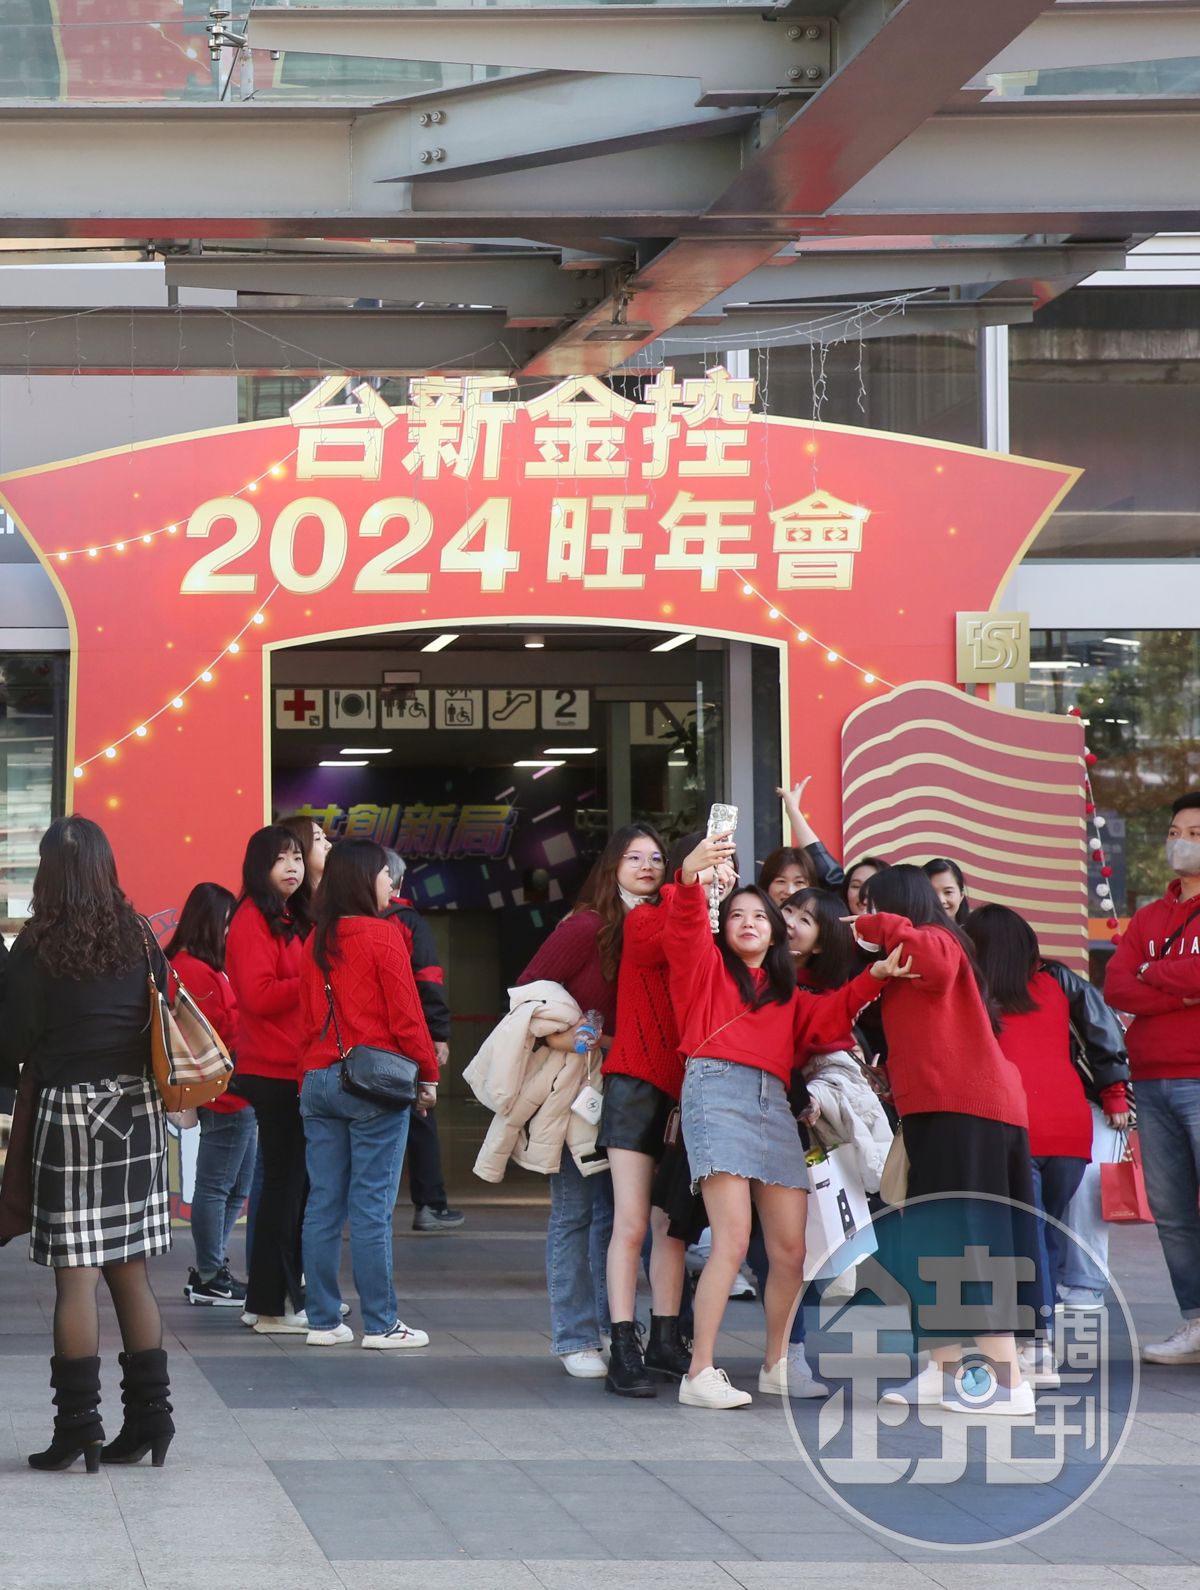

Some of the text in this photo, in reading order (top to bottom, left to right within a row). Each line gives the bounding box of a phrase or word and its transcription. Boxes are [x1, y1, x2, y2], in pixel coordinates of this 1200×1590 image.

[288, 366, 756, 480] 台新金控
[180, 489, 871, 594] 2024 旺年會
[554, 689, 577, 718] 2
